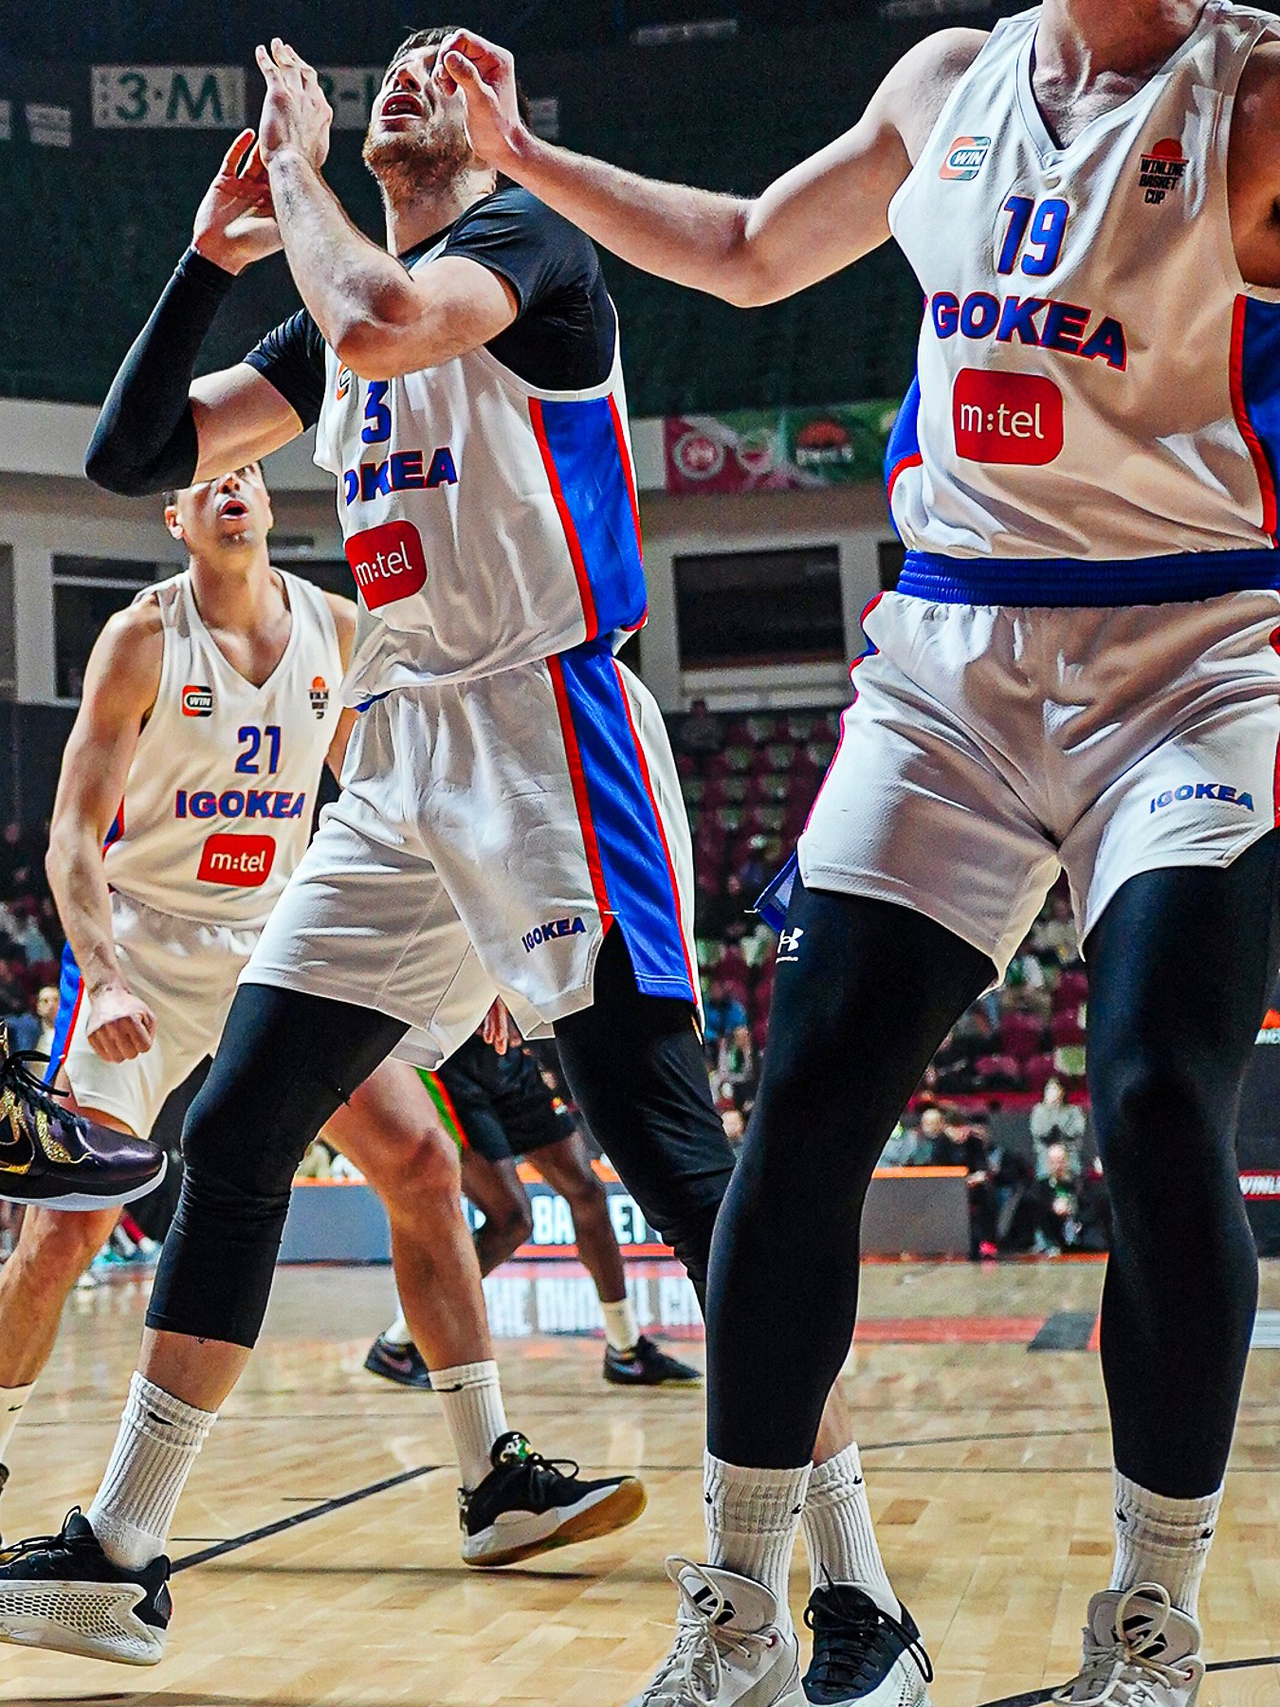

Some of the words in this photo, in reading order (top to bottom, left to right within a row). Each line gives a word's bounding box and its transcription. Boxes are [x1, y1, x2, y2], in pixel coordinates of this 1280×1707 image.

[954, 149, 984, 167] WIN
[1144, 189, 1166, 205] CUP
[997, 195, 1070, 277] 19
[923, 291, 1127, 372] GOKEA
[361, 379, 392, 445] 3
[960, 403, 1044, 440] m:tel
[355, 541, 413, 587] m:tel
[188, 695, 211, 707] WIN
[234, 725, 281, 775] 21
[175, 790, 306, 820] IGOKEA
[1149, 782, 1255, 815] IGOKEA
[210, 850, 266, 873] m:tel
[521, 916, 587, 954] IGOKEA
[531, 1194, 647, 1245] BAET
